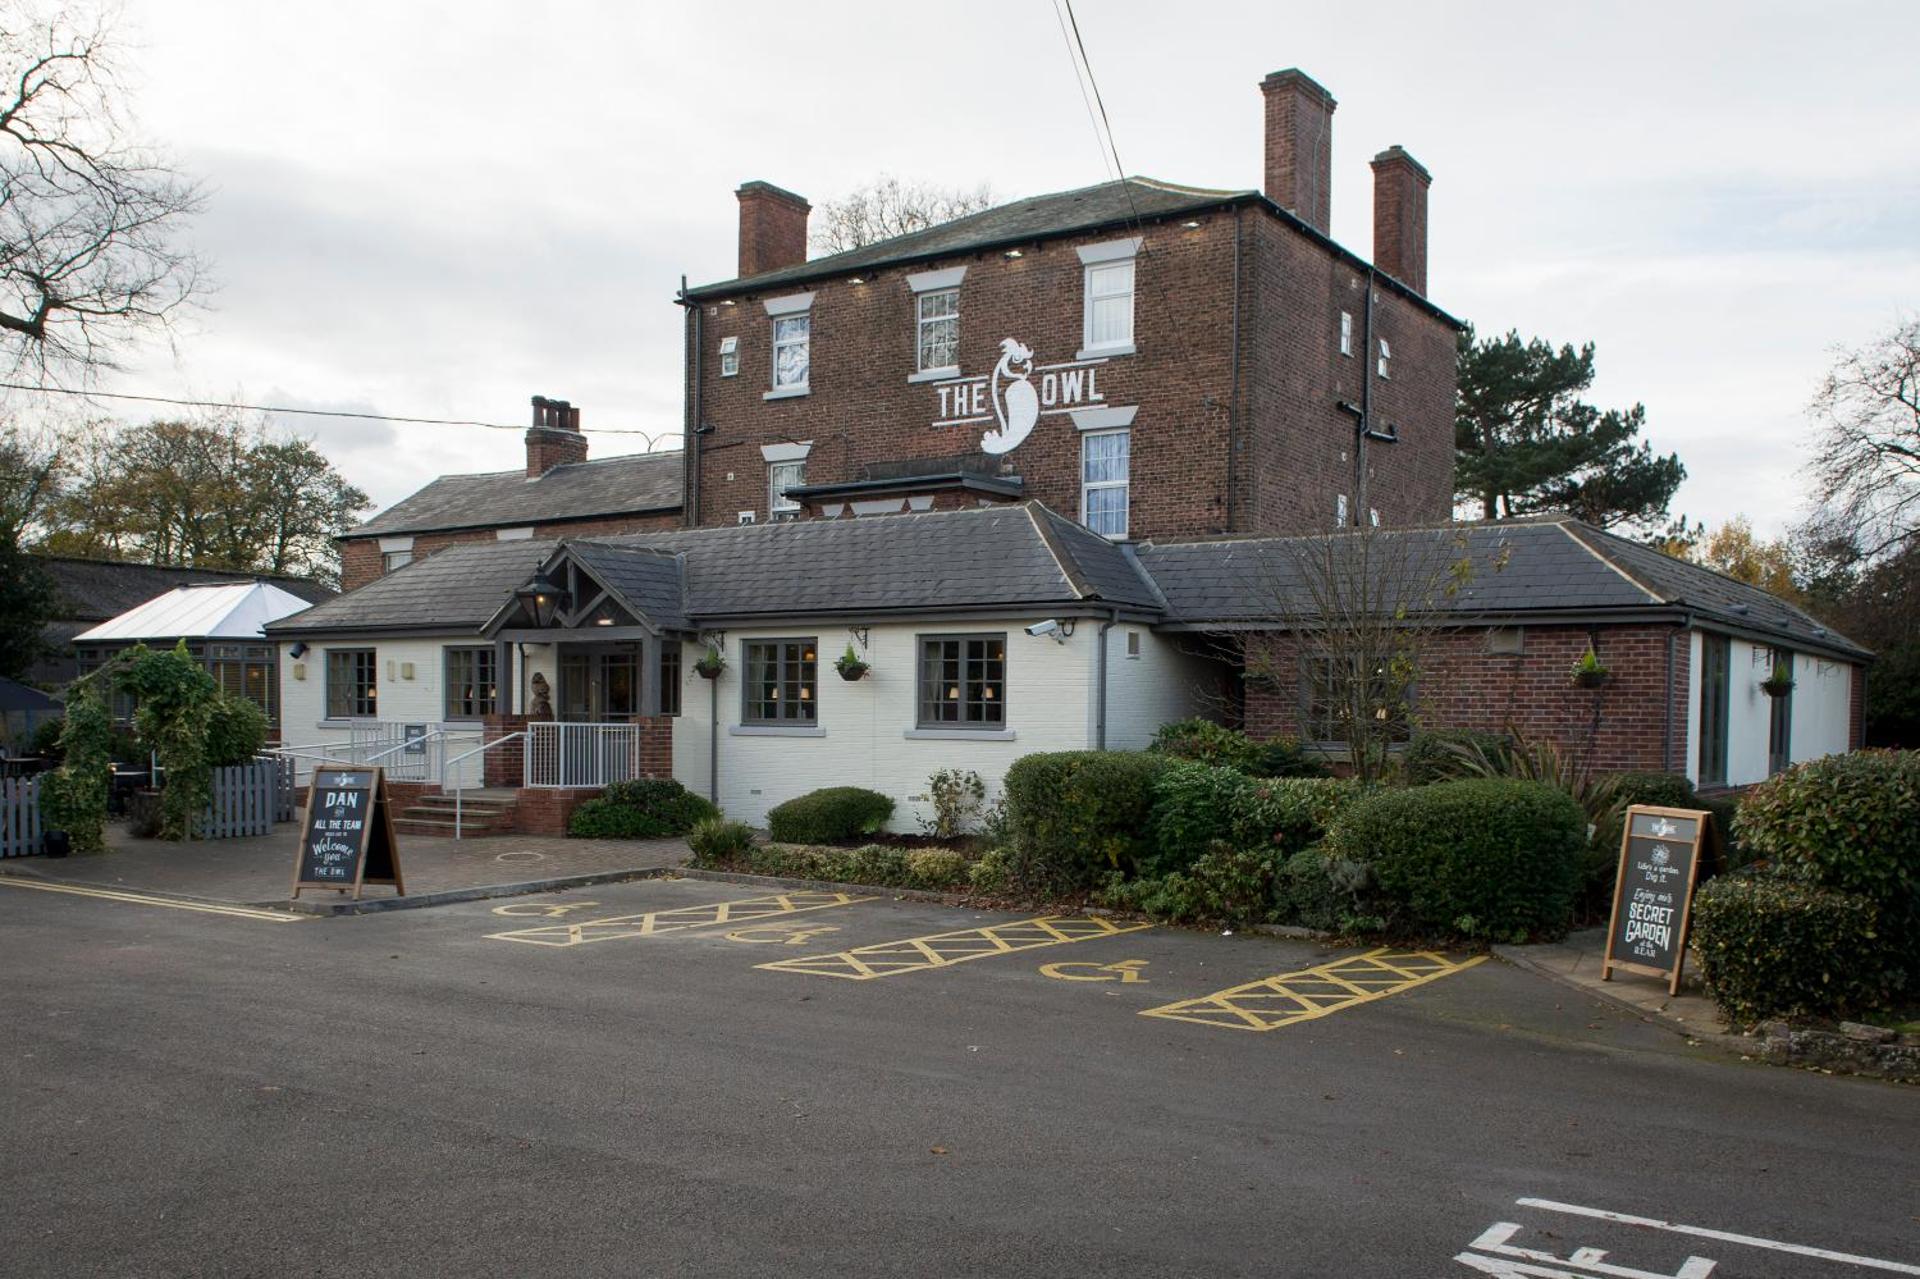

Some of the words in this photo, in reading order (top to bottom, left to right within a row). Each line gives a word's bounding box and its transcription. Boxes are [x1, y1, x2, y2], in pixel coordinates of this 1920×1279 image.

[938, 382, 987, 417] THE
[1042, 368, 1104, 406] OWL
[325, 791, 358, 808] DAN
[314, 819, 326, 829] ALL
[329, 820, 342, 829] THE
[343, 820, 362, 830] TEAM
[312, 837, 354, 856] Welcome
[1633, 888, 1656, 904] Enjoy
[1629, 902, 1674, 925] SECRET
[1625, 920, 1671, 951] GARDEN
[1634, 946, 1656, 958] REAR
